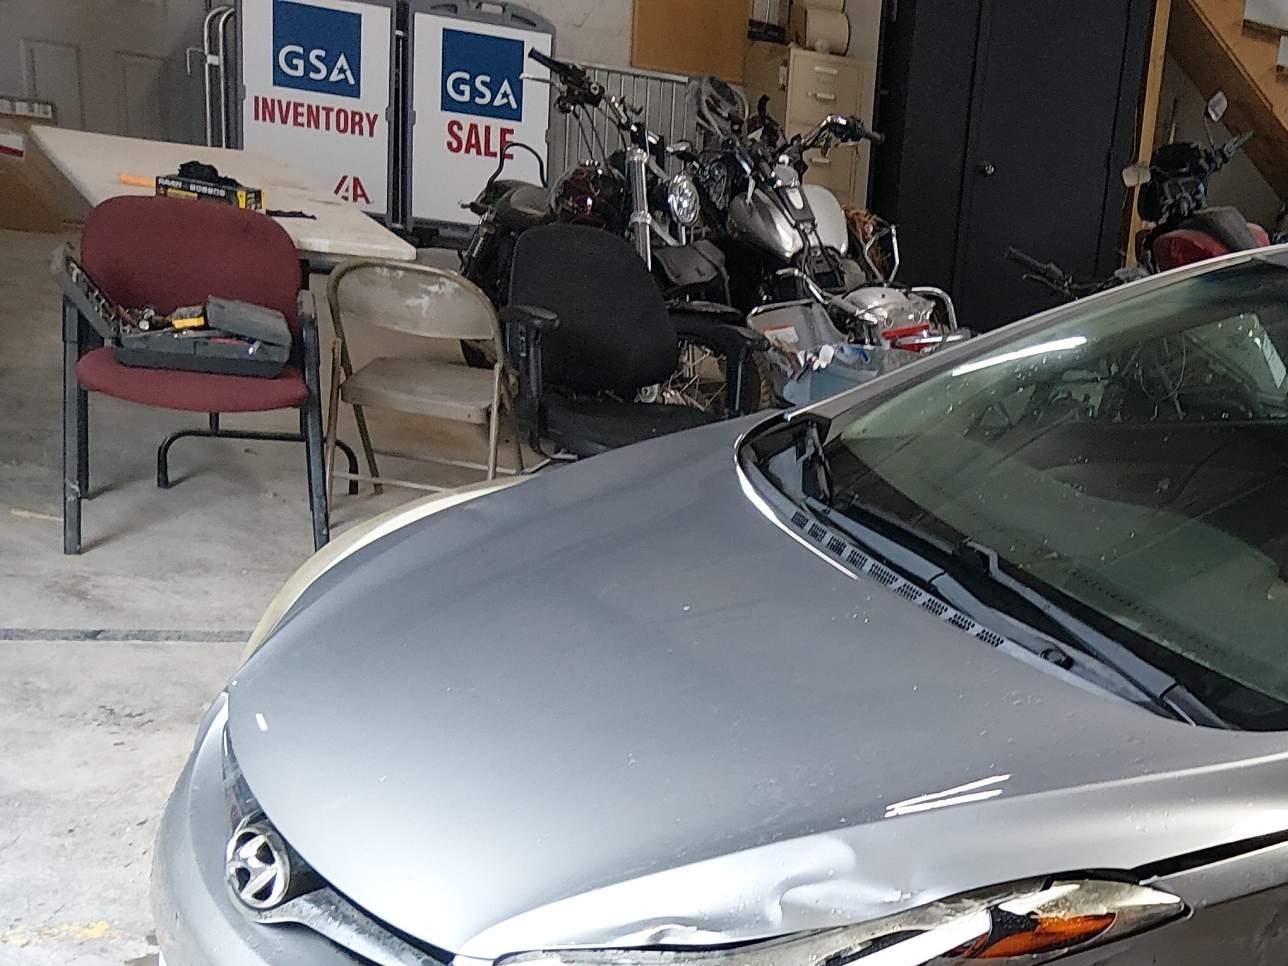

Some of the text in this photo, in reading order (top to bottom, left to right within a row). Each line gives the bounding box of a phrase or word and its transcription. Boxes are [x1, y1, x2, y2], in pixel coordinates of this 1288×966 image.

[278, 44, 356, 85] GSA
[446, 71, 518, 110] GSA
[254, 96, 378, 138] INVENTORY
[446, 120, 515, 160] SALE
